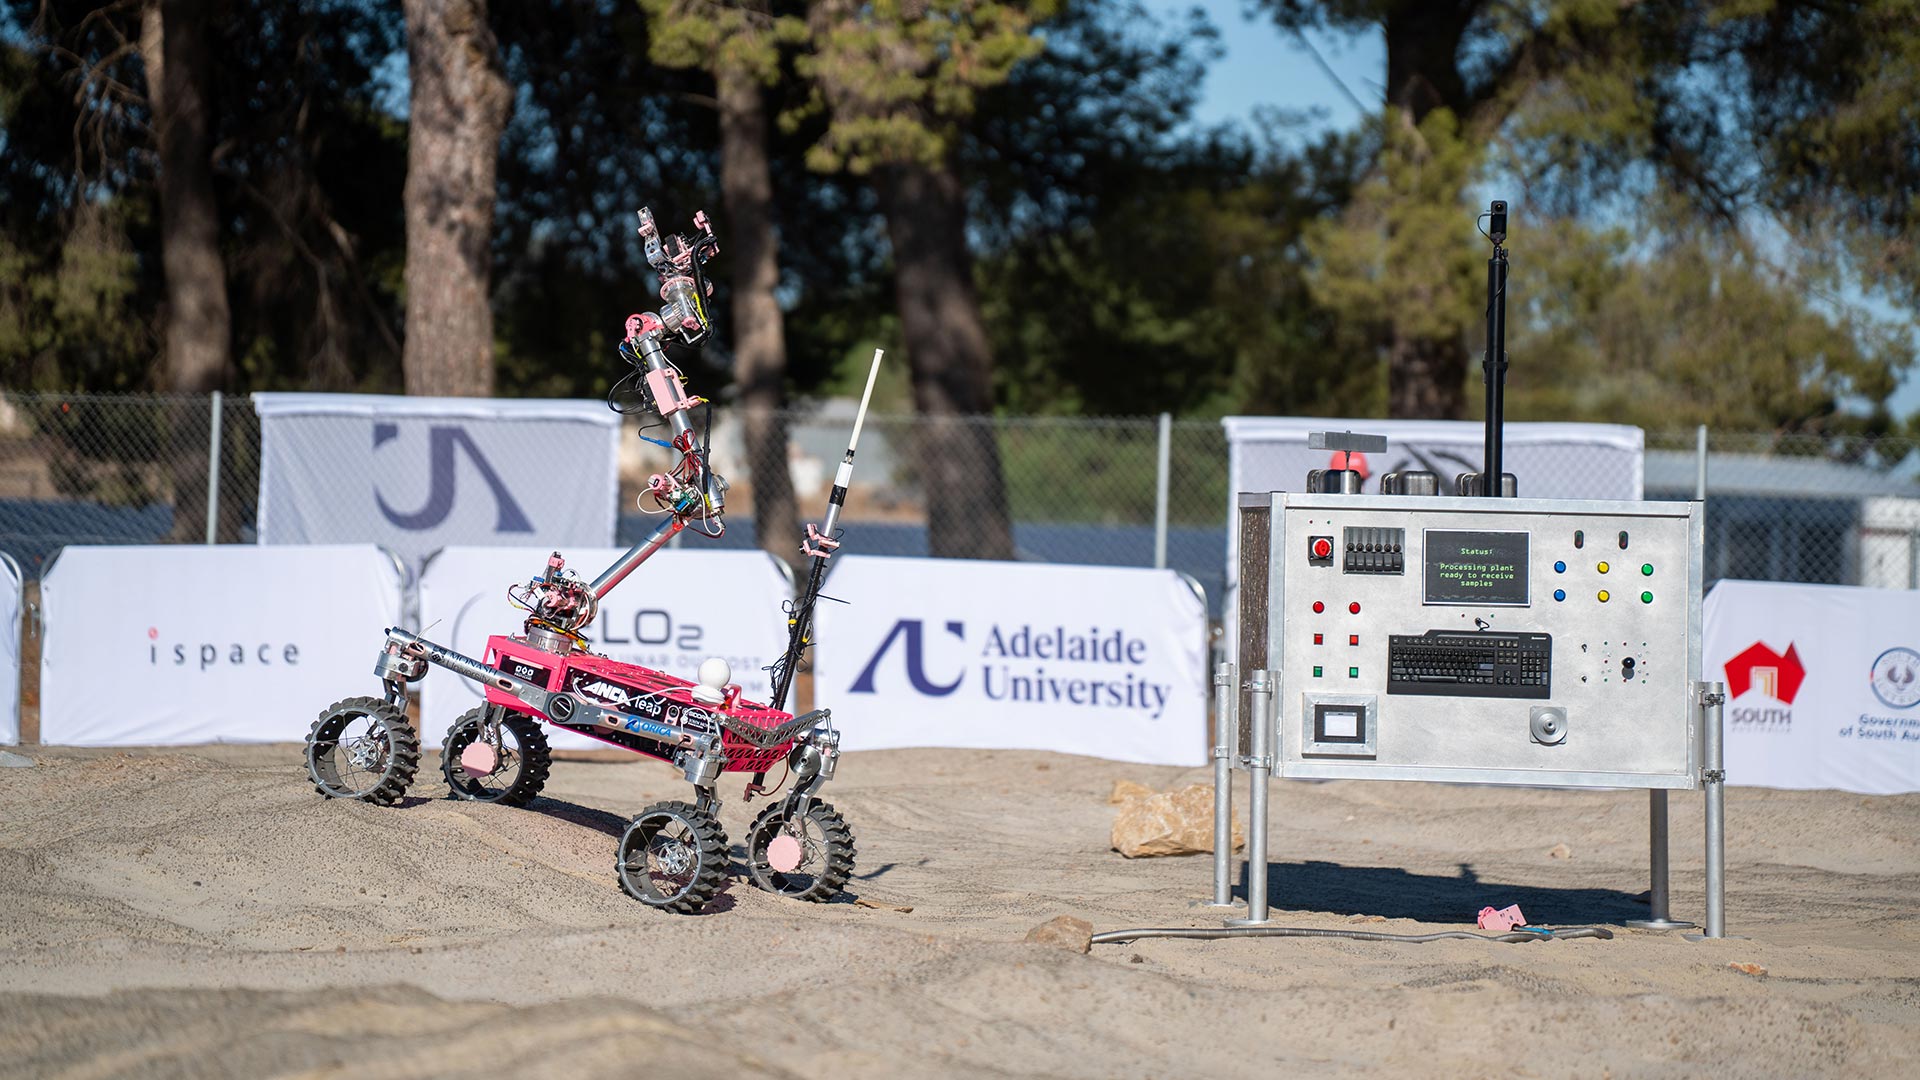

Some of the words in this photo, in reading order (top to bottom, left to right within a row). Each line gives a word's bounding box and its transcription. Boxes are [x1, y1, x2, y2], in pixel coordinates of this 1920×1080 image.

[1461, 547, 1493, 555] Status:
[1440, 563, 1486, 572] Processing
[1490, 564, 1514, 572] plant
[1461, 580, 1493, 588] samples
[587, 608, 704, 650] LO2
[983, 625, 1146, 664] Adelaide
[446, 660, 491, 684] University
[450, 651, 498, 676] MONASH
[582, 681, 632, 707] ANCA
[983, 665, 1170, 719] University
[1731, 708, 1792, 724] SOUTH
[641, 722, 672, 737] ORICA
[1838, 725, 1853, 736] of
[1858, 727, 1896, 739] South
